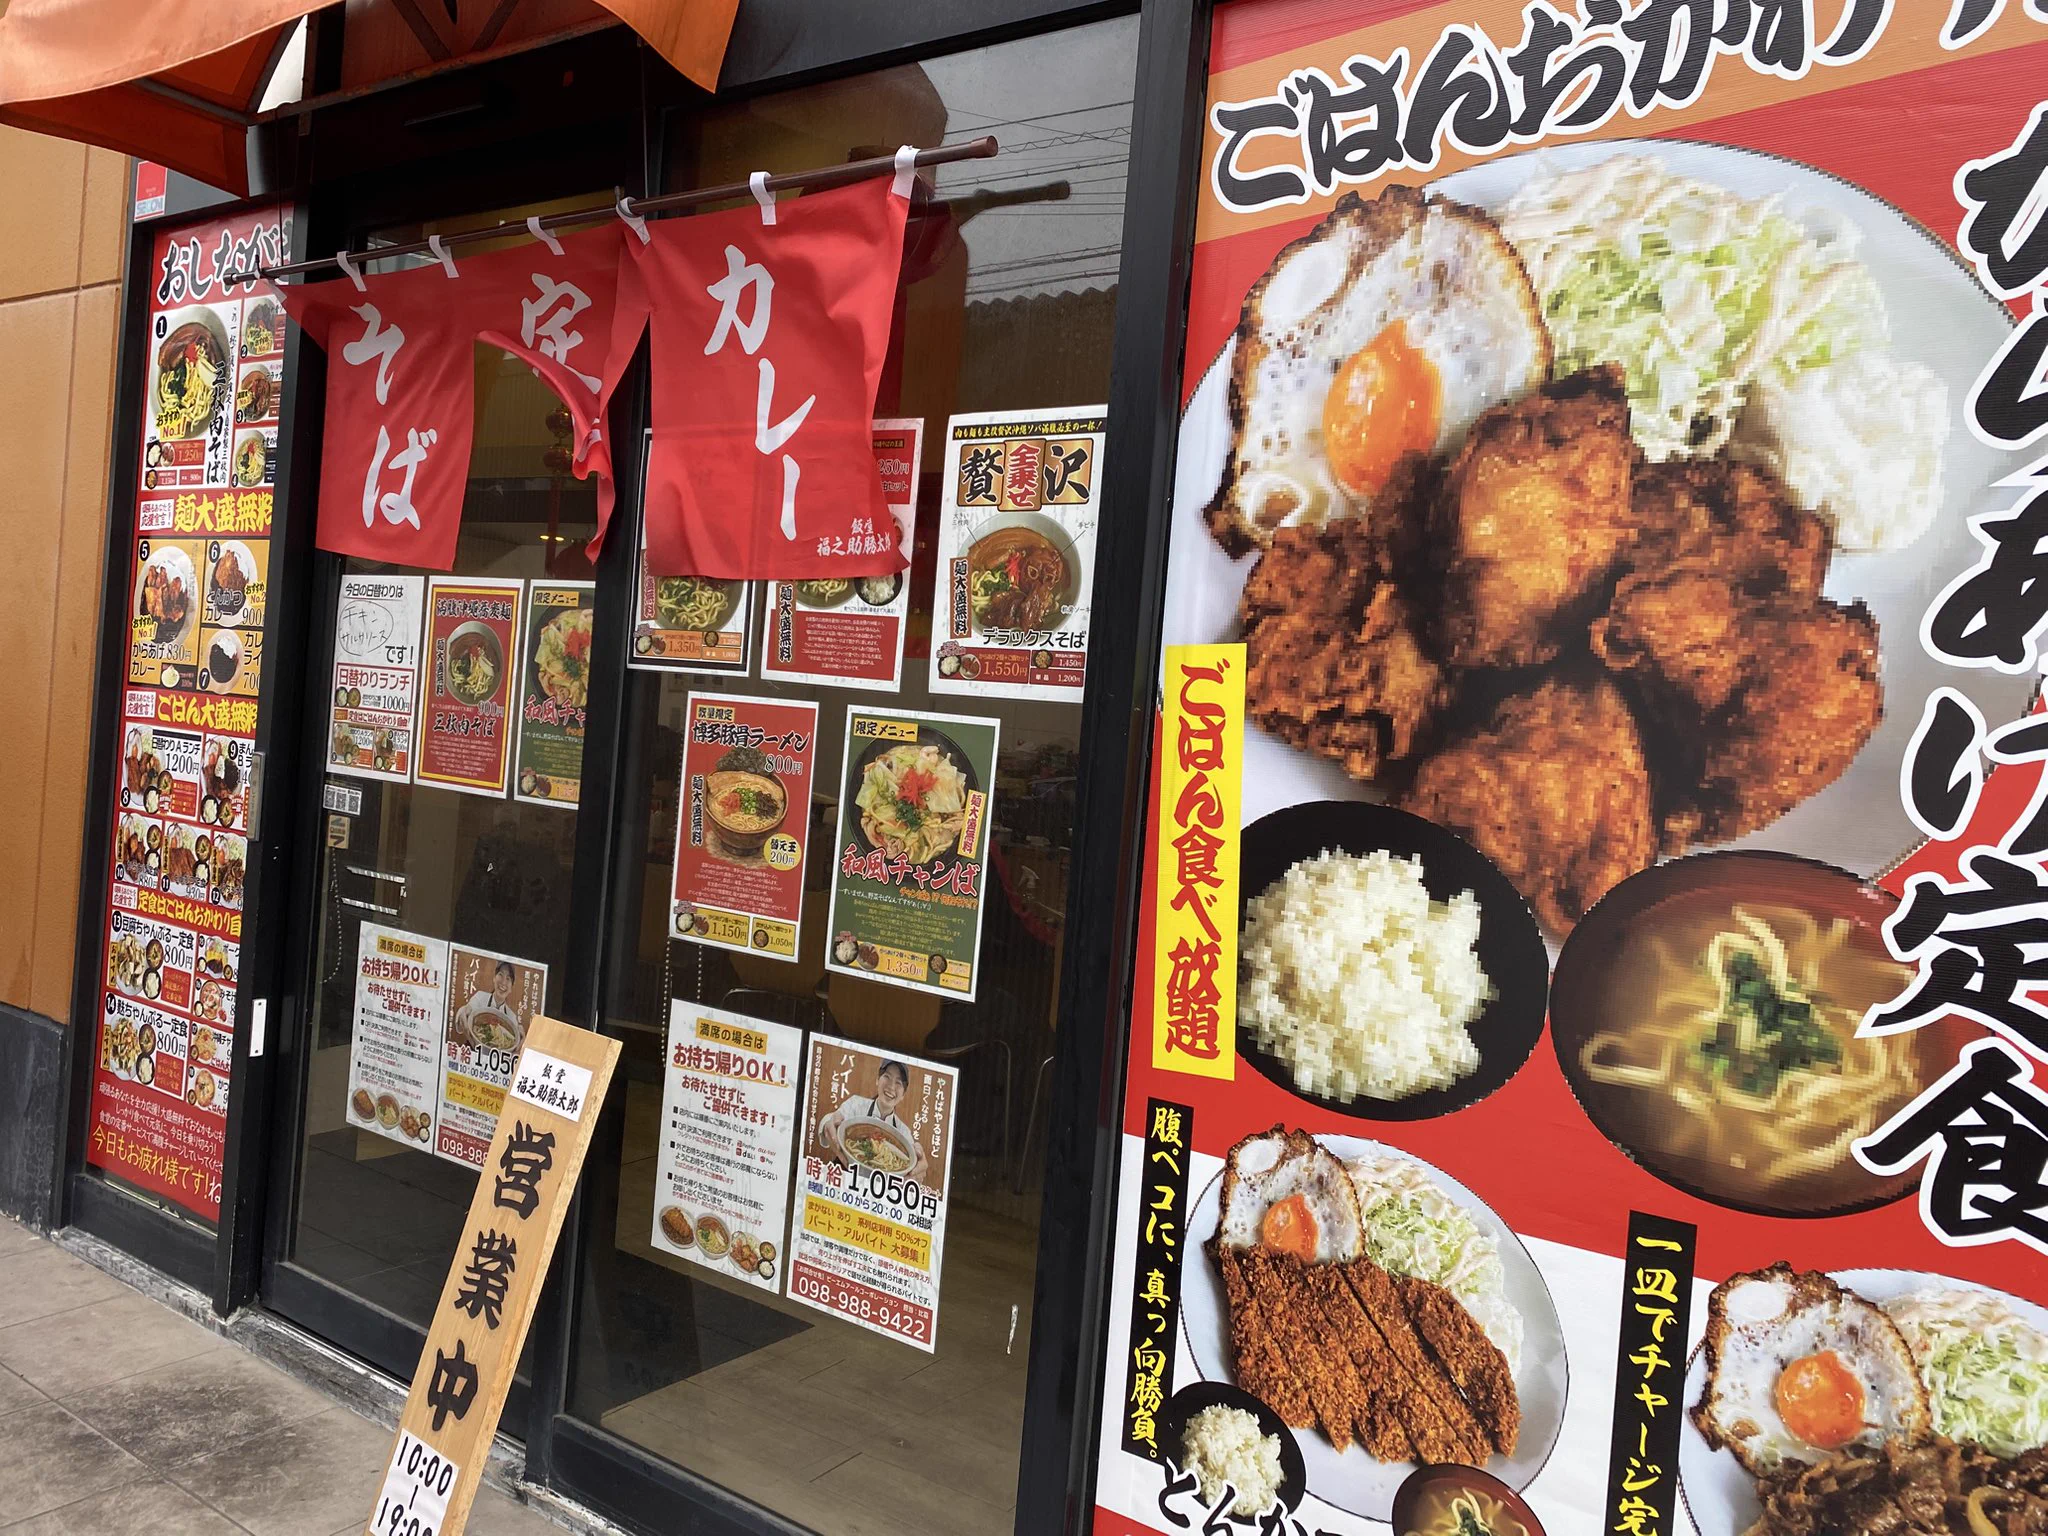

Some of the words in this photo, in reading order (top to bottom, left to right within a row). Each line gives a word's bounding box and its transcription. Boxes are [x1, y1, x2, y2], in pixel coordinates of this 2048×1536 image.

[705, 245, 817, 541] カレー
[156, 409, 181, 426] おすすめ
[206, 362, 227, 484] 三枚肉そば
[342, 302, 437, 530] そば
[961, 448, 1004, 503] 贅
[1005, 442, 1041, 508] 全乗せ
[1044, 444, 1090, 502] 沢
[850, 518, 875, 535] 飯堂
[206, 588, 243, 606] とんかつ
[245, 583, 265, 595] おすすめ
[345, 582, 404, 598] 今日の日替わりは
[534, 592, 577, 605] 限定メニュー
[953, 559, 968, 636] 麺大盛無料
[132, 615, 153, 629] おすすめ
[204, 608, 233, 622] カレー
[779, 584, 793, 663] 麺大盛無料
[132, 642, 166, 659] からあげ
[167, 644, 192, 661] 830円
[982, 628, 1087, 649] デラックスそば
[130, 660, 156, 676] カレー
[339, 668, 410, 692] 日替わりランチ
[983, 661, 1028, 677] 1,550円
[382, 694, 410, 712] 1000円
[697, 705, 734, 721] 数量限定
[433, 713, 496, 737] 三枚肉そば
[691, 722, 811, 752] 博多豚骨ラーメン
[854, 719, 917, 739] 限定メニュー
[166, 754, 200, 775] 1200円
[765, 754, 803, 775] 800円
[961, 793, 983, 855] 麺大盛無料
[769, 850, 795, 866] 200円
[840, 843, 981, 897] 和風チャンば
[1165, 658, 1230, 1060] ごはん食べ放題
[711, 922, 747, 940] 1,150円
[769, 936, 793, 948] 1,050円
[164, 944, 193, 970] 800円
[379, 938, 424, 959] 満席の場合は
[361, 957, 439, 987] お持ち帰りOK!
[470, 958, 480, 995] バイト
[885, 958, 924, 977] 1,350円
[367, 981, 411, 1005] お待たせせずに
[381, 998, 431, 1022] ご提供できます!
[157, 1031, 186, 1058] 800円
[699, 1022, 764, 1050] 満席の場合は
[447, 1041, 472, 1064] 時給
[673, 1042, 787, 1085] お持ち帰りOK!
[541, 1063, 566, 1084] 飯堂
[840, 1054, 856, 1099] バイト
[516, 1076, 580, 1114] 福之助勝太郎
[681, 1074, 745, 1105] お待たせせずに
[921, 1074, 932, 1124] 面白くなる
[703, 1096, 776, 1128] ご提供できます!
[931, 1077, 946, 1158] やればやるほど
[912, 1112, 922, 1140] ものを
[806, 1157, 843, 1188] 時給
[848, 1163, 937, 1219] 1,050円
[807, 1180, 824, 1195] 時間
[907, 1212, 933, 1231] 応相談
[807, 1200, 835, 1216] まかない
[837, 1210, 851, 1222] あり
[857, 1216, 893, 1238] 系列店利用
[895, 1227, 928, 1247] 50%オフ
[808, 1214, 887, 1251] パート・アルバイト
[891, 1242, 926, 1265] 大募集!
[427, 1118, 557, 1431] 営業中
[798, 1276, 925, 1340] 098-988-9422
[397, 1435, 453, 1496] 10:00
